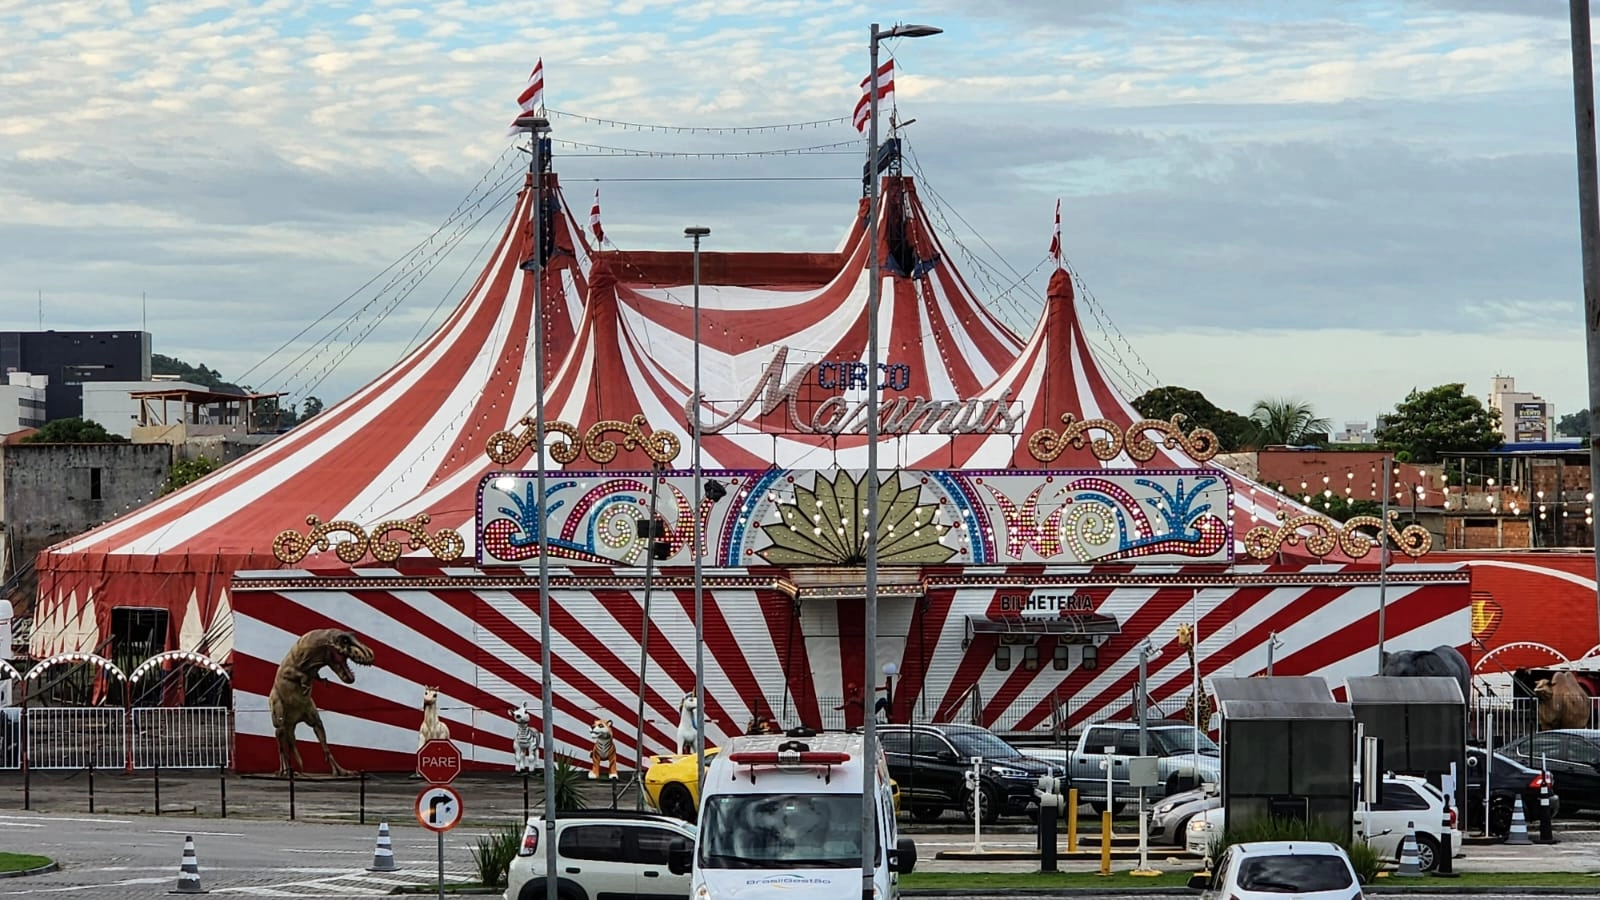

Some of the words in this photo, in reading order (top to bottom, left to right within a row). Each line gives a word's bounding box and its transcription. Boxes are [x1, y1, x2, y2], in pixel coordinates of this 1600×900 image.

[818, 360, 910, 391] CIRCO
[1000, 594, 1094, 612] BILHETERIA
[422, 756, 457, 768] PARE
